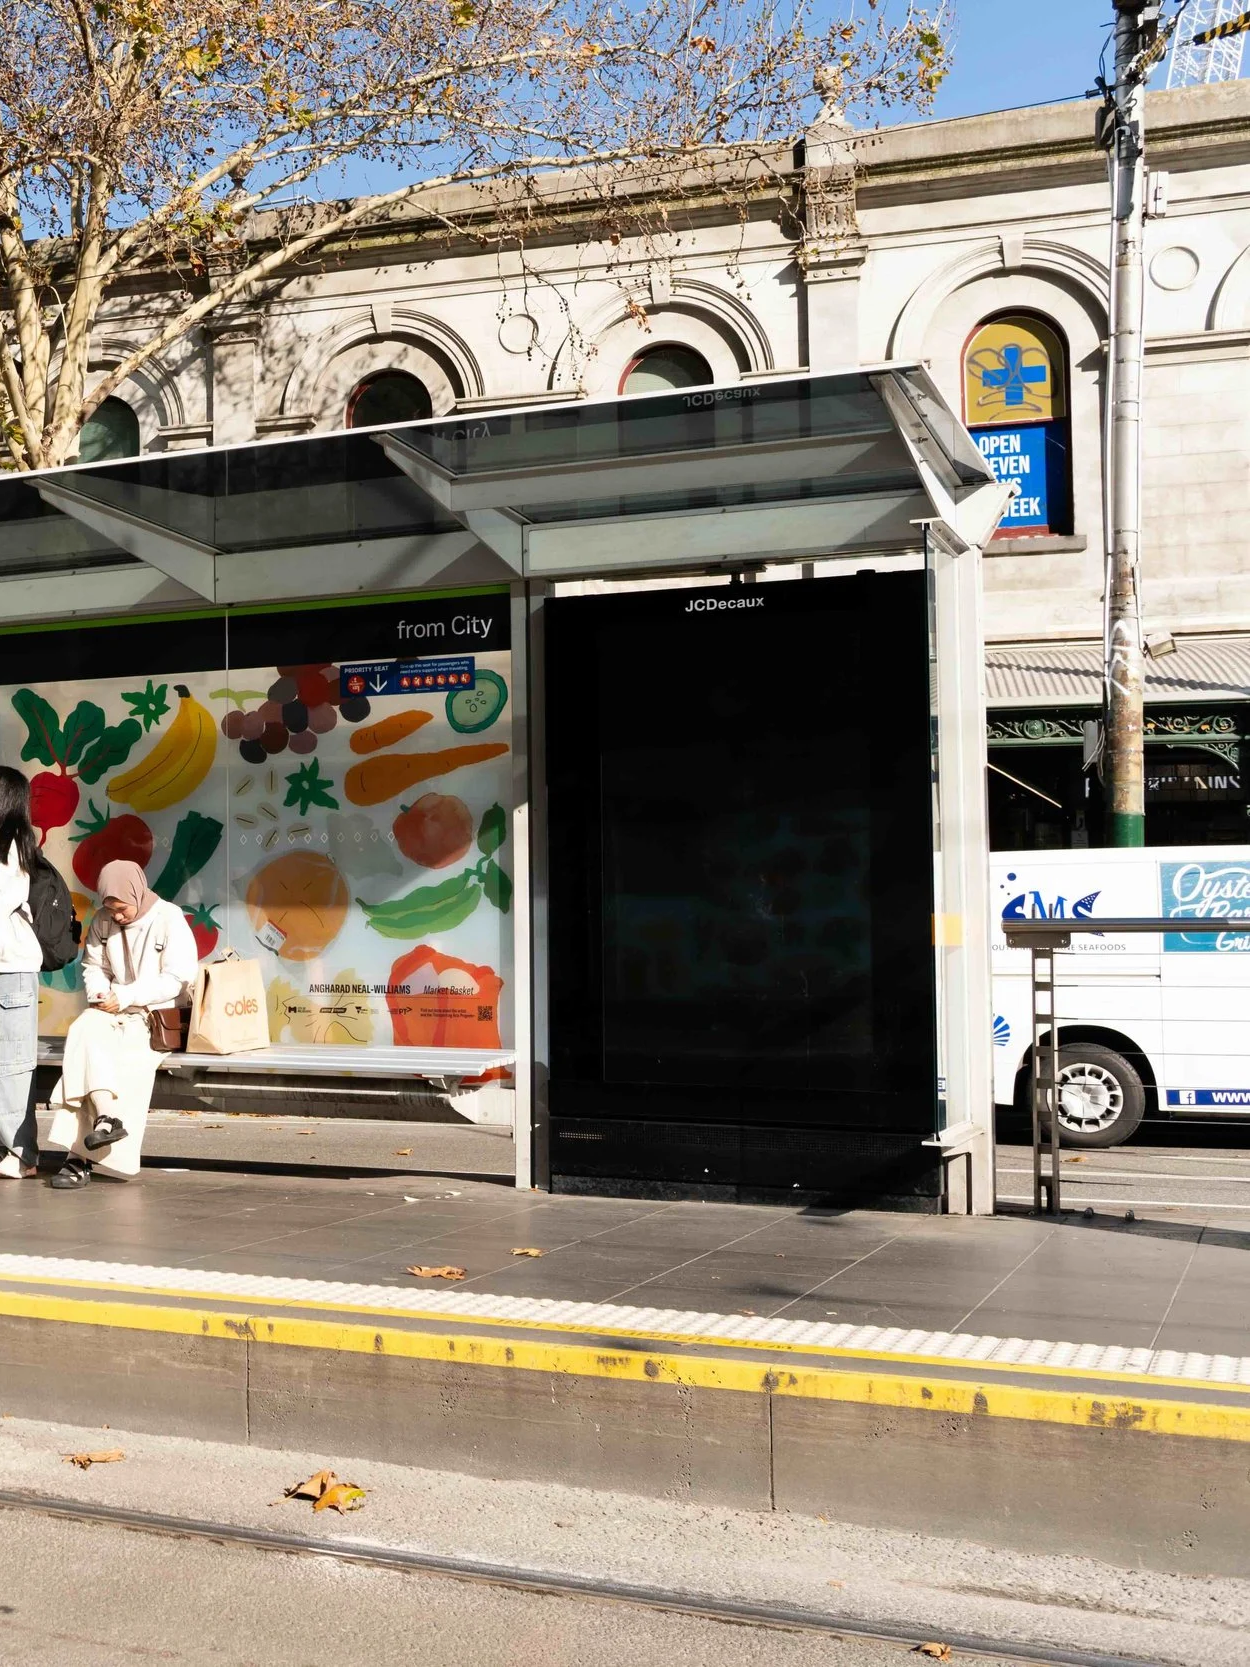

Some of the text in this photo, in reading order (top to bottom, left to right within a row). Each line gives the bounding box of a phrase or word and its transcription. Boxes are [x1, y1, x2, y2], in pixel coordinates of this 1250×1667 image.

[979, 434, 1021, 455] OPEN
[685, 598, 764, 612] JCDecaux
[397, 615, 492, 639] from City
[344, 666, 371, 674] PRIORITY
[309, 984, 411, 994] ANGHARAD NEAL-WILLIAMS
[423, 985, 474, 995] Market Basket
[225, 995, 258, 1017] coles
